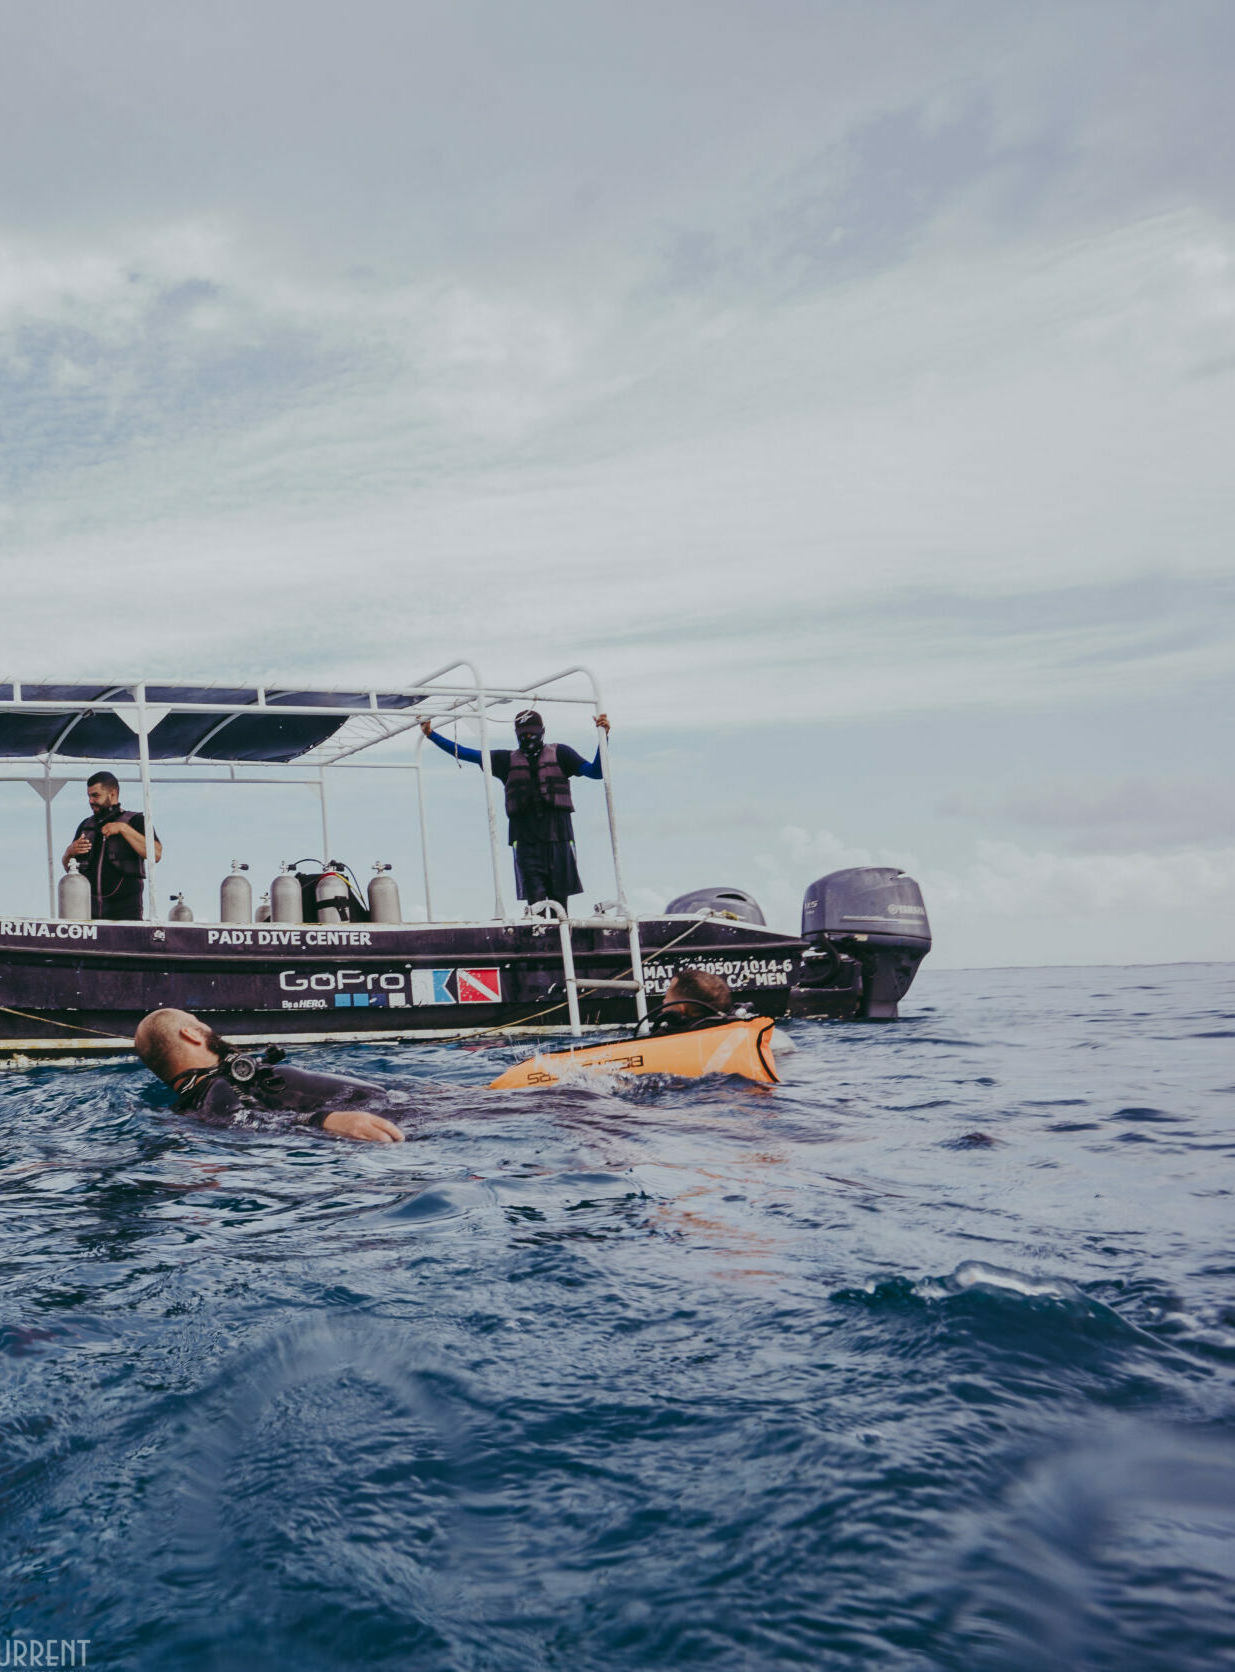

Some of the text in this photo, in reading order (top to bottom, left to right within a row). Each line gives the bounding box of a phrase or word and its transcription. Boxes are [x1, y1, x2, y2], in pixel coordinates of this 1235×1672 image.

[208, 930, 372, 946] PADI DIVE CENTER
[279, 970, 405, 991] GoPro
[644, 965, 675, 979] MAT
[645, 971, 788, 994] PLA CAMEN
